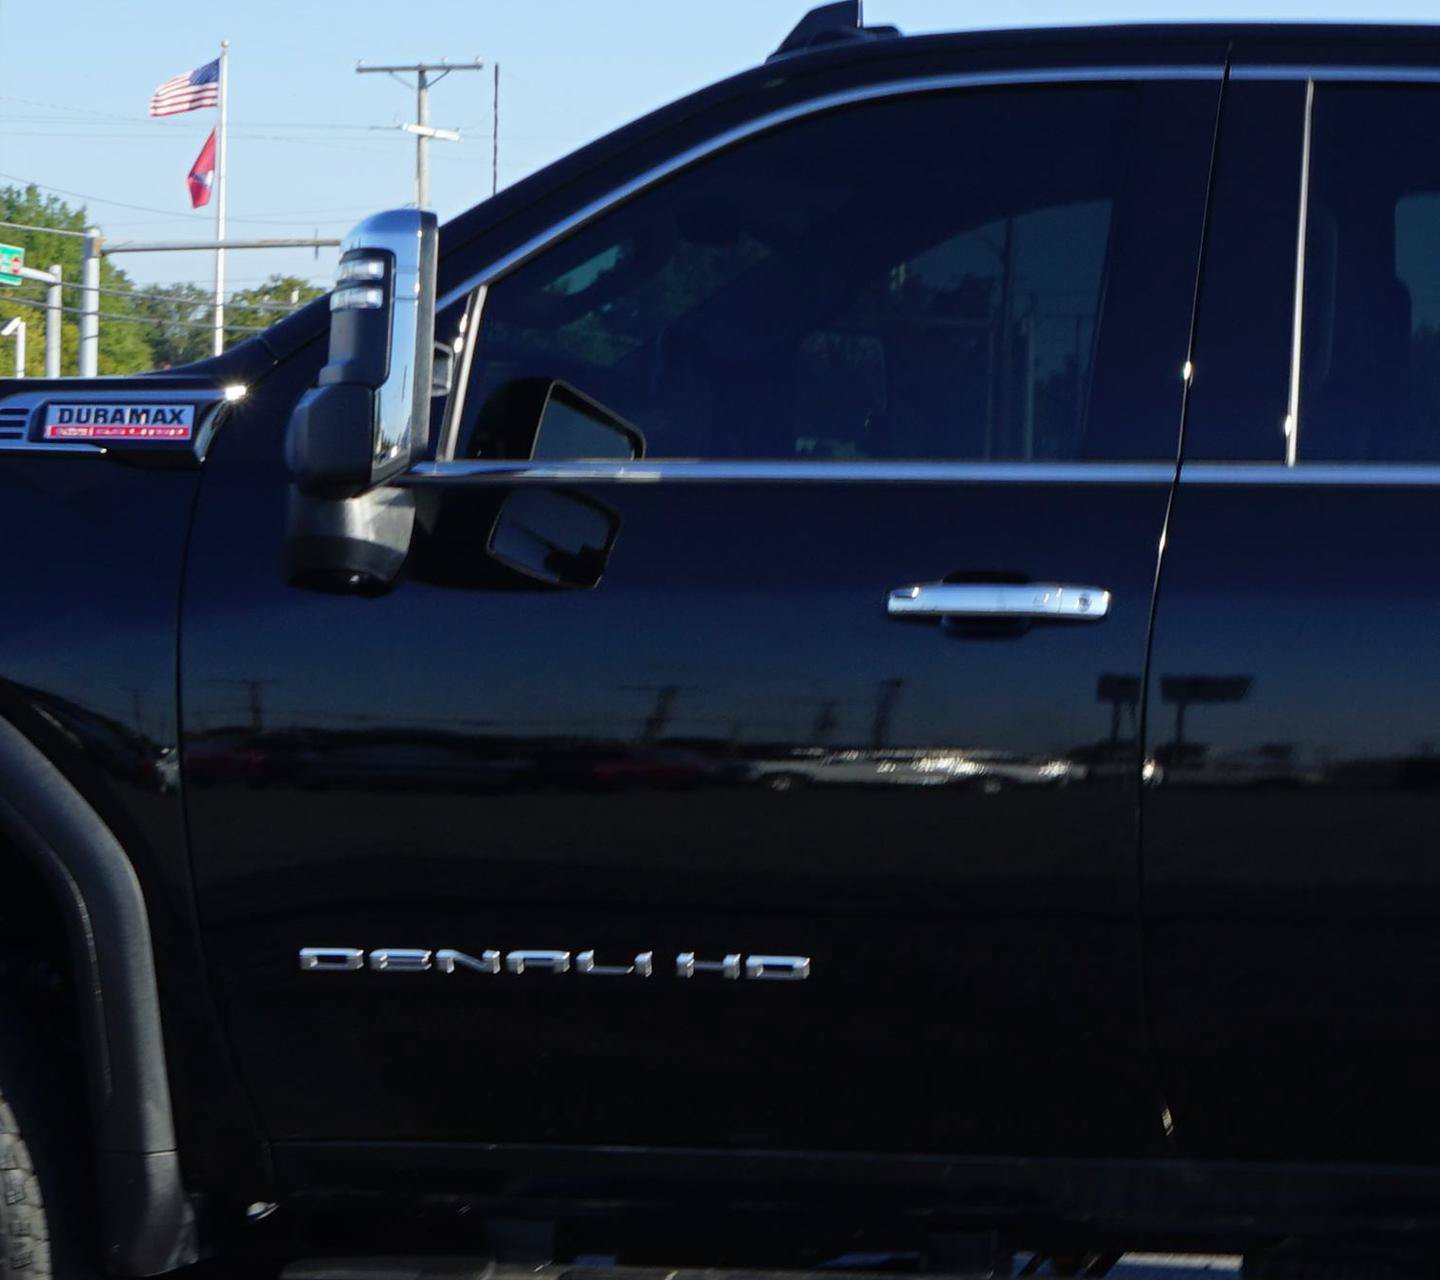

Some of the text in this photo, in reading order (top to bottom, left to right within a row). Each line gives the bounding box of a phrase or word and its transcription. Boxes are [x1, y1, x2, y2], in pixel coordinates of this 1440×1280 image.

[58, 407, 185, 425] DURAMAX
[299, 947, 810, 980] DENALI HD
